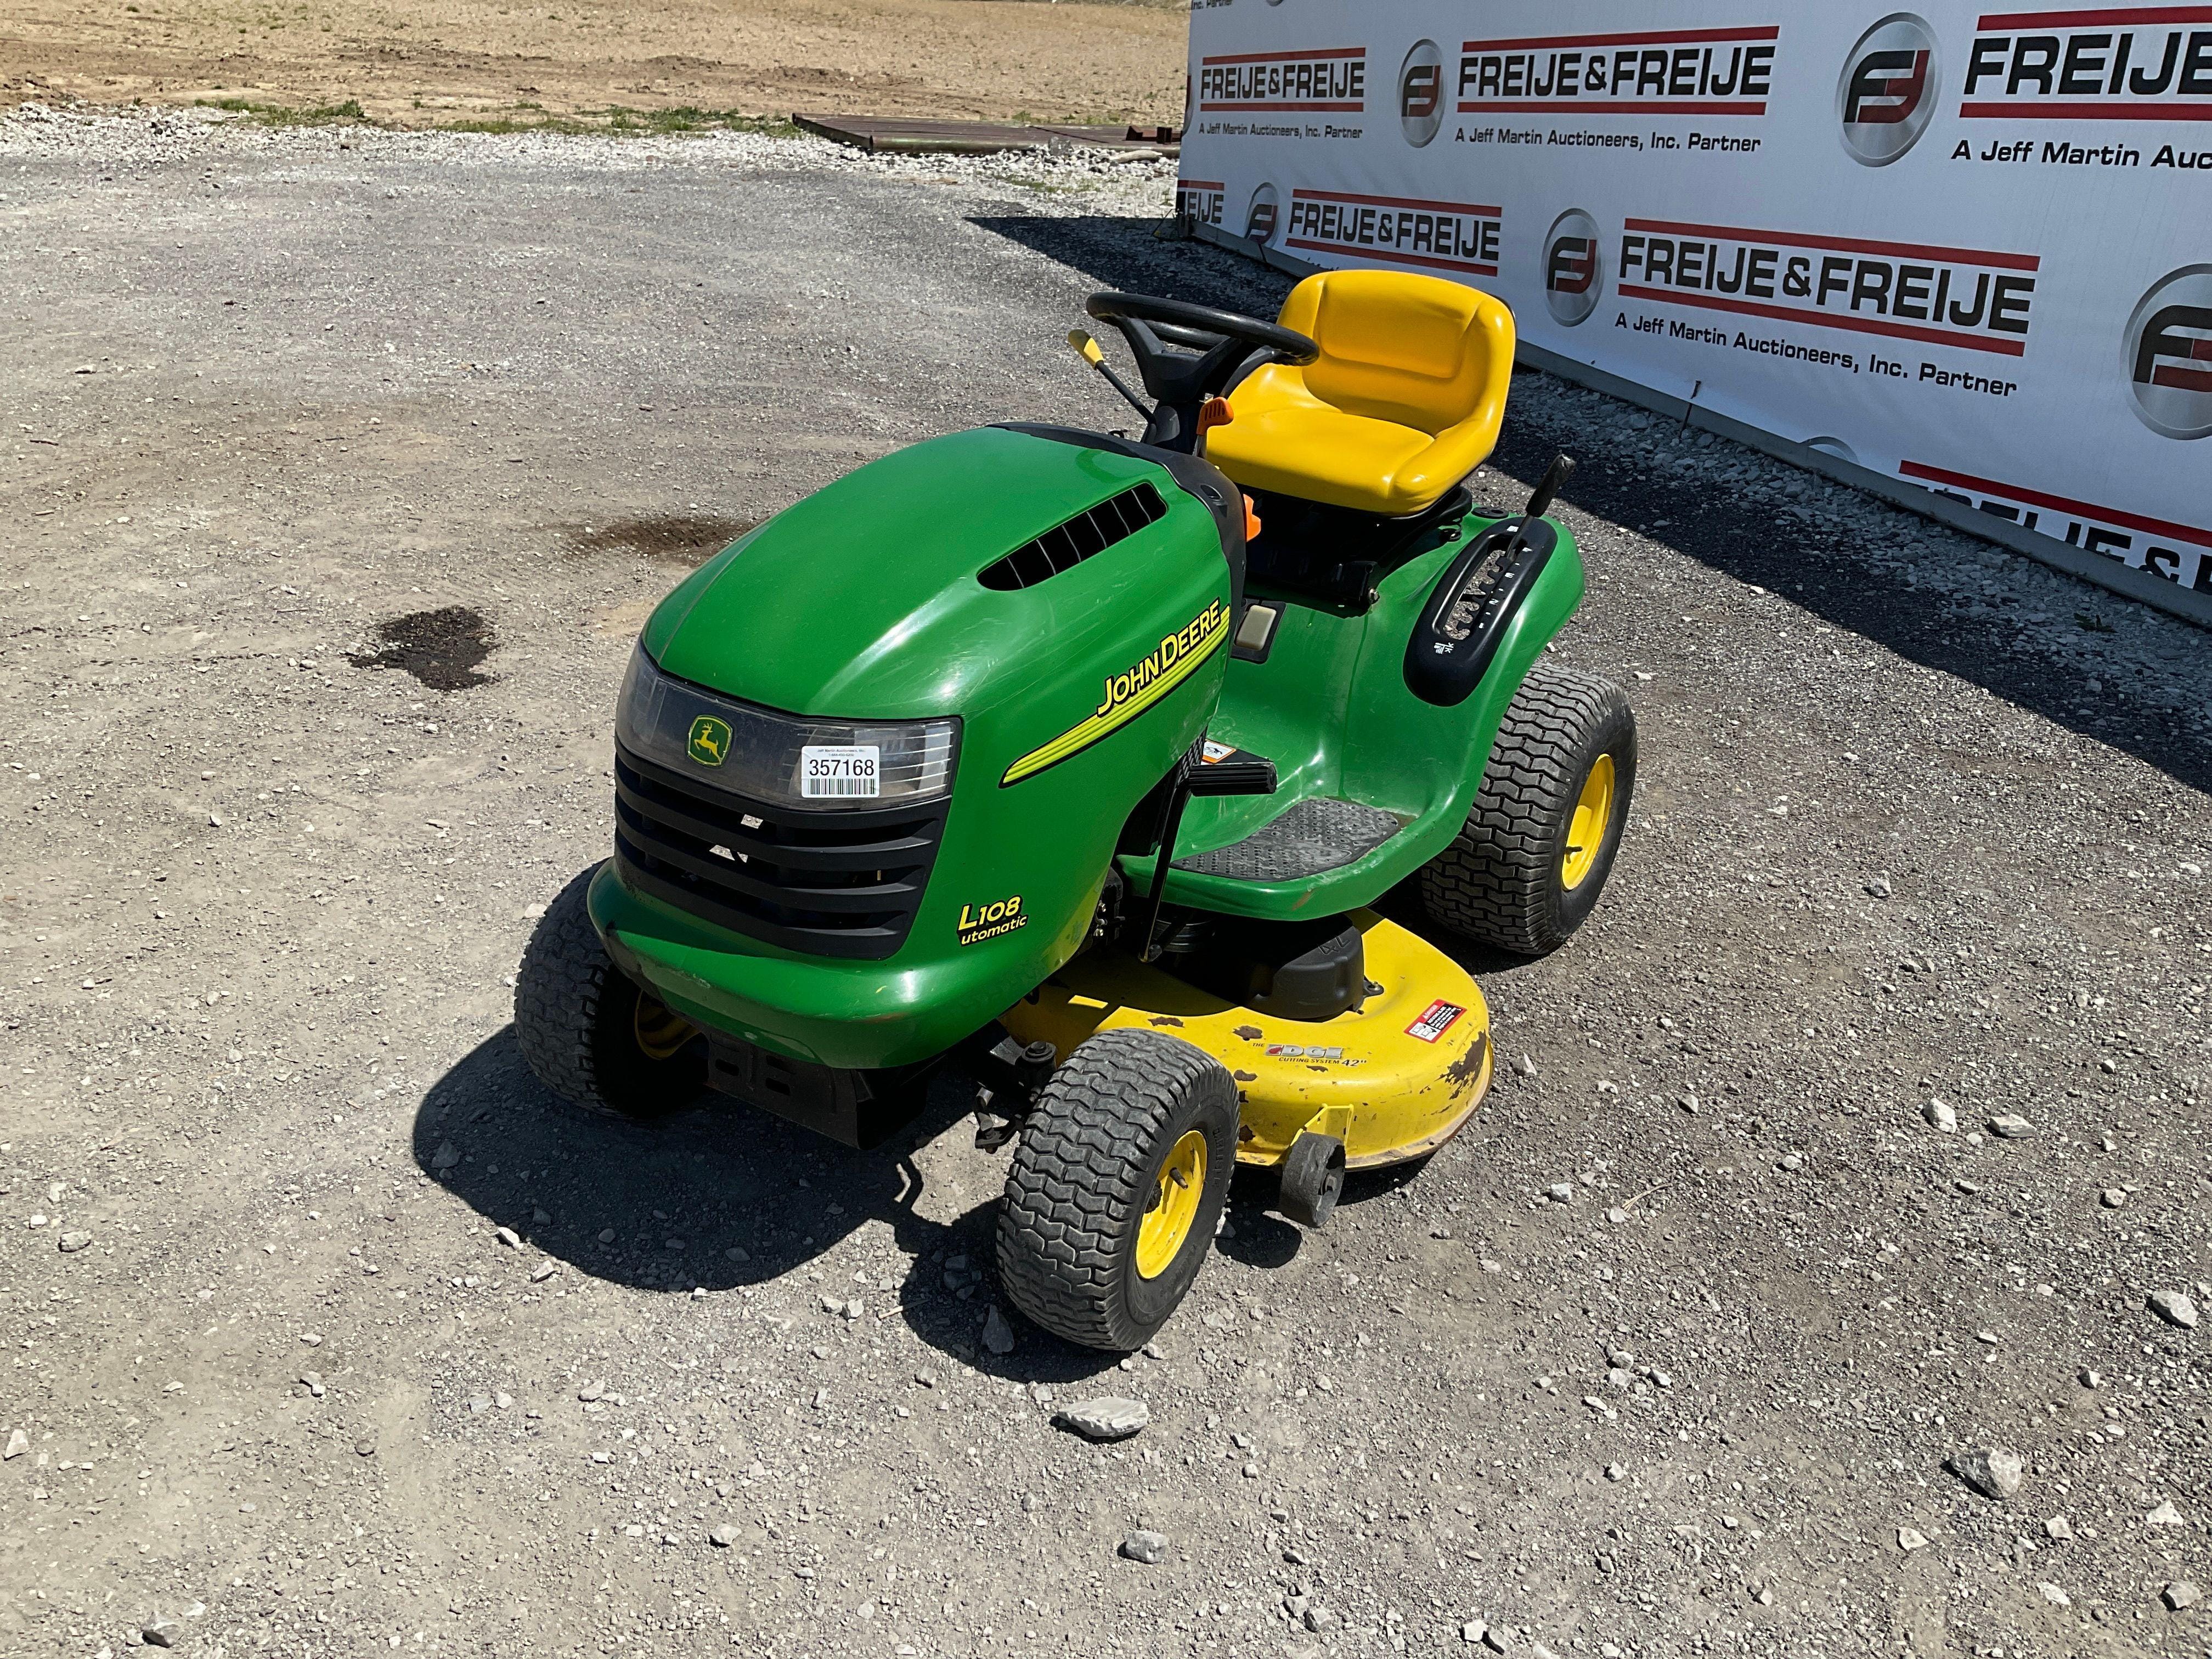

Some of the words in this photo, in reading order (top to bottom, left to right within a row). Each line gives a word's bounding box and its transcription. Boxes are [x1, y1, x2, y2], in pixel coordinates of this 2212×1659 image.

[1964, 32, 2212, 95] FREIJE
[1199, 123, 1205, 134] A
[1207, 123, 1221, 134] Jeff
[1222, 123, 1248, 135] Martin
[1250, 123, 1302, 139] Auctioneers,
[1305, 125, 1321, 137] Inc.
[1324, 125, 1363, 138] Partner
[1455, 128, 1465, 143] A
[1469, 128, 1494, 143] Jeff
[1498, 129, 1542, 144] Martin
[1547, 130, 1643, 151] Auctioneers,
[1651, 132, 1680, 149] Inc.
[1688, 133, 1760, 152] Partner
[1951, 139, 1972, 160] A
[1981, 140, 2033, 163] Jeff
[2041, 142, 2140, 166] Martin
[2150, 145, 2212, 170] Auc
[1615, 312, 1628, 328] A
[1633, 315, 1664, 335] Jeff
[1669, 322, 1727, 347] Martin
[1733, 332, 1860, 374] Auctioneers,
[1869, 354, 1909, 379] Inc.
[1919, 363, 2017, 397] Partner
[1097, 650, 1159, 716] JOHN
[1160, 599, 1220, 670] DEERE
[809, 759, 874, 776] 357168
[958, 896, 1021, 931] L108
[961, 916, 1027, 945] utomatic
